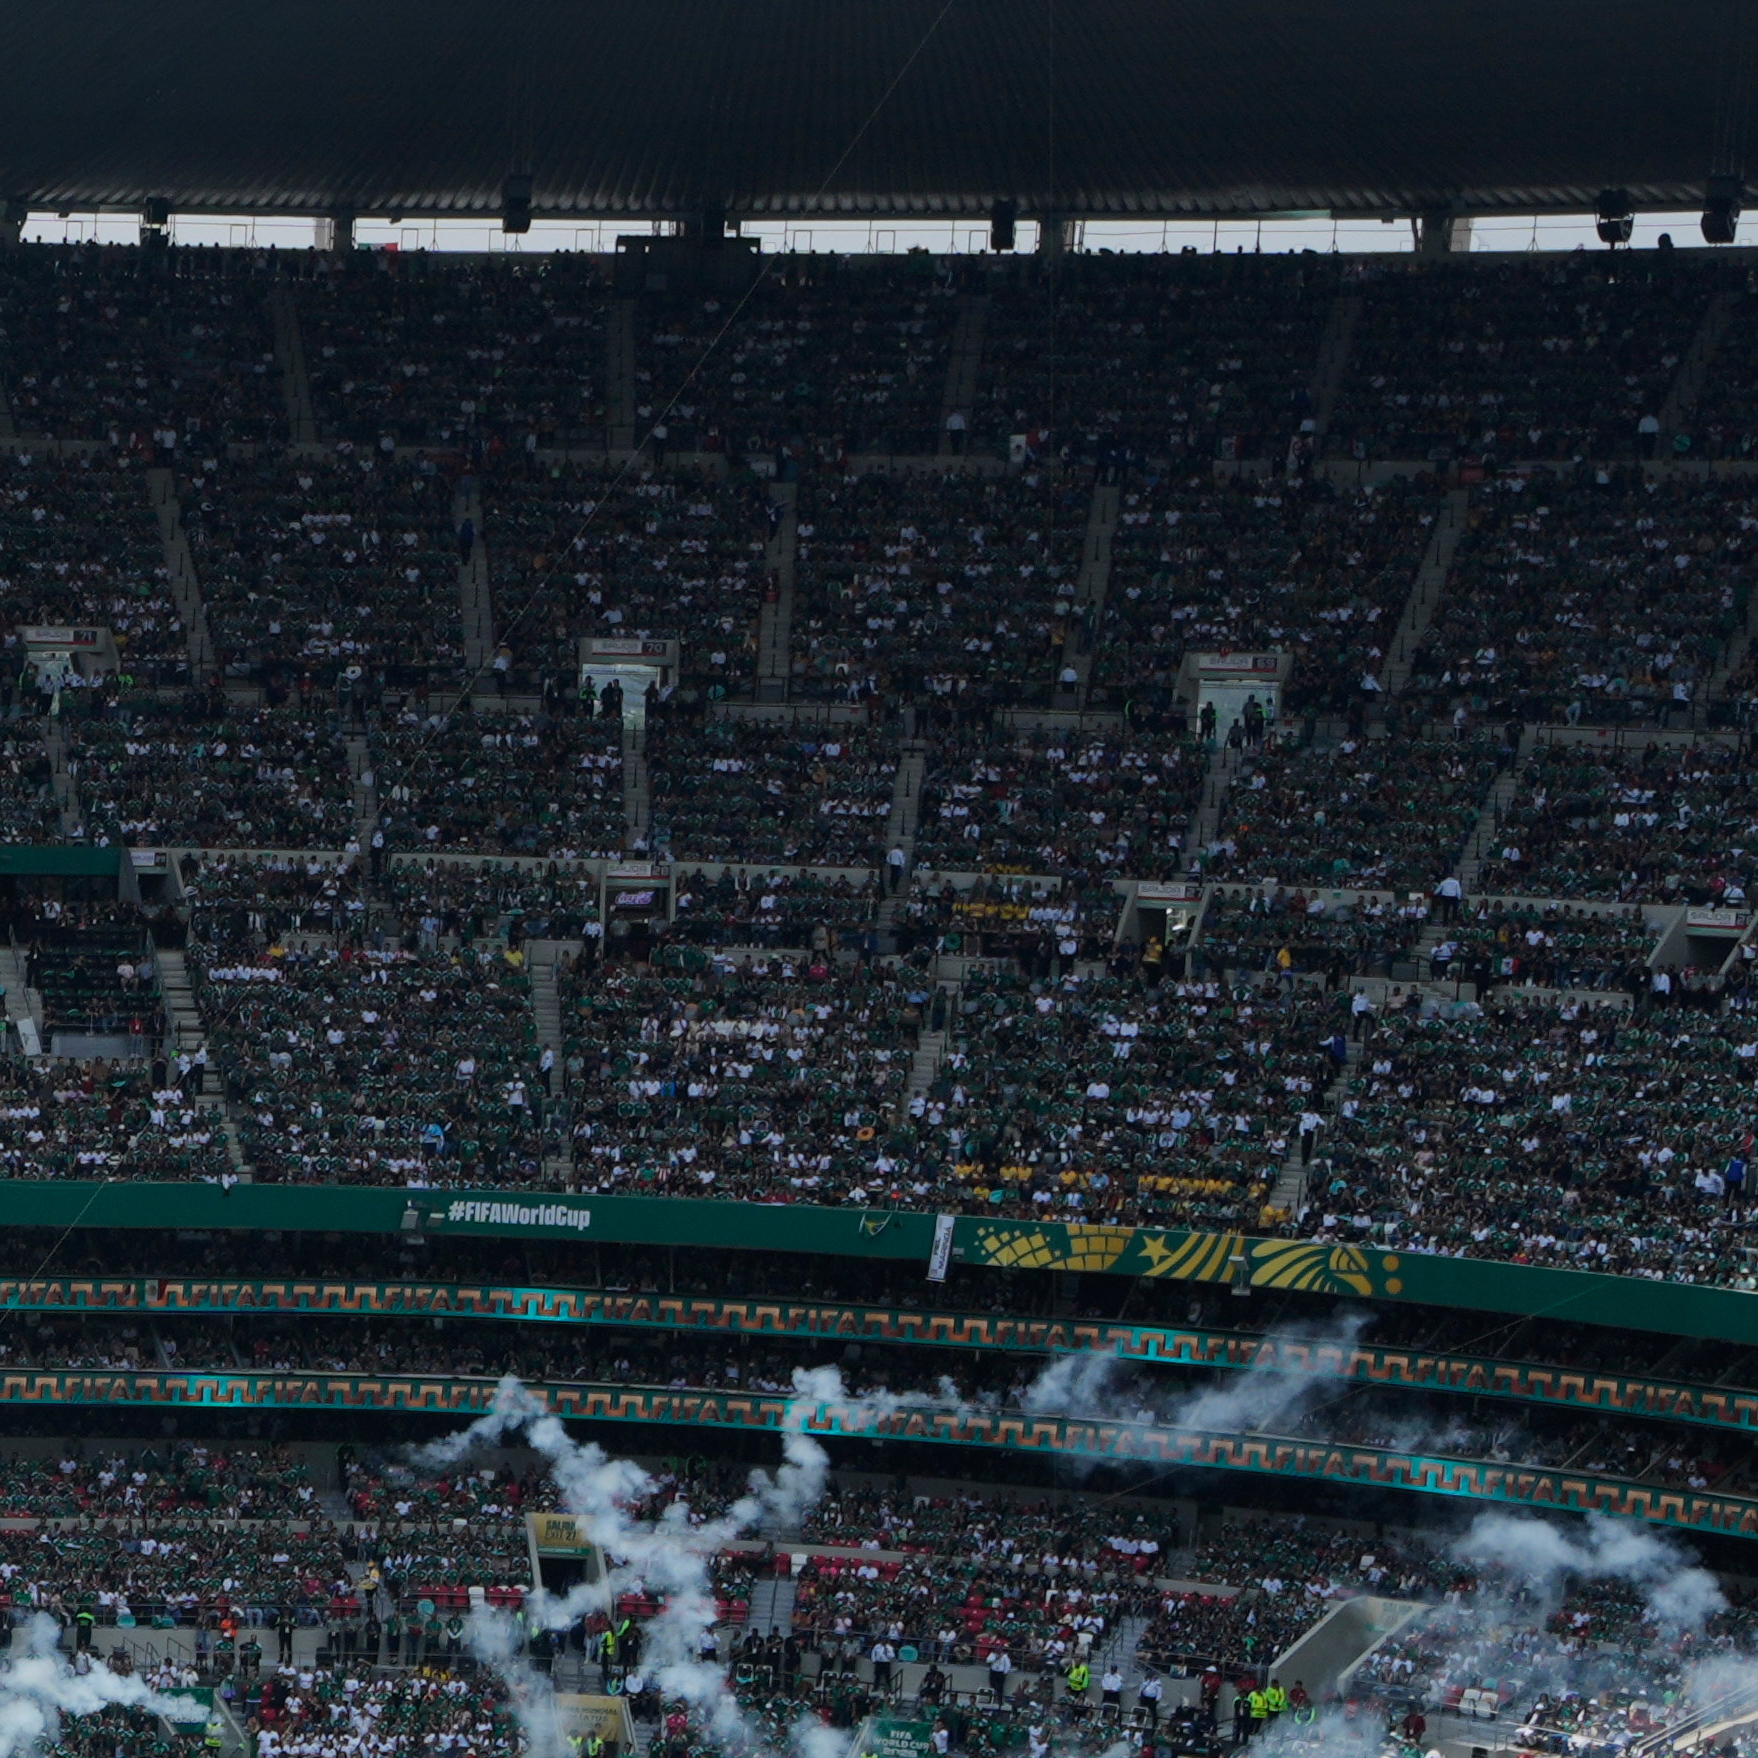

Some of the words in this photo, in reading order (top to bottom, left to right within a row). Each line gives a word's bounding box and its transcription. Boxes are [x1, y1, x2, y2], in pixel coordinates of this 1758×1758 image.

[448, 1199, 591, 1231] #FIFAWorldCup
[1, 1281, 64, 1305] FIFA
[192, 1285, 257, 1308] FIFA
[385, 1287, 452, 1312] FIFA
[585, 1296, 655, 1323] FIFA
[789, 1308, 858, 1335] FIFA
[996, 1320, 1079, 1350] FIFA
[1208, 1337, 1280, 1370] FIFA
[1417, 1356, 1486, 1389] FIFA
[1625, 1383, 1695, 1416] FIFA
[66, 1377, 131, 1401] FIFA
[256, 1381, 323, 1404] FIFA
[652, 1397, 721, 1423] FIFA
[1274, 1445, 1346, 1477] FIFA
[1484, 1470, 1556, 1505] FIFA
[1690, 1498, 1758, 1534] FIFA
[890, 1730, 913, 1740] FIFA
[909, 1740, 930, 1750] CUP
